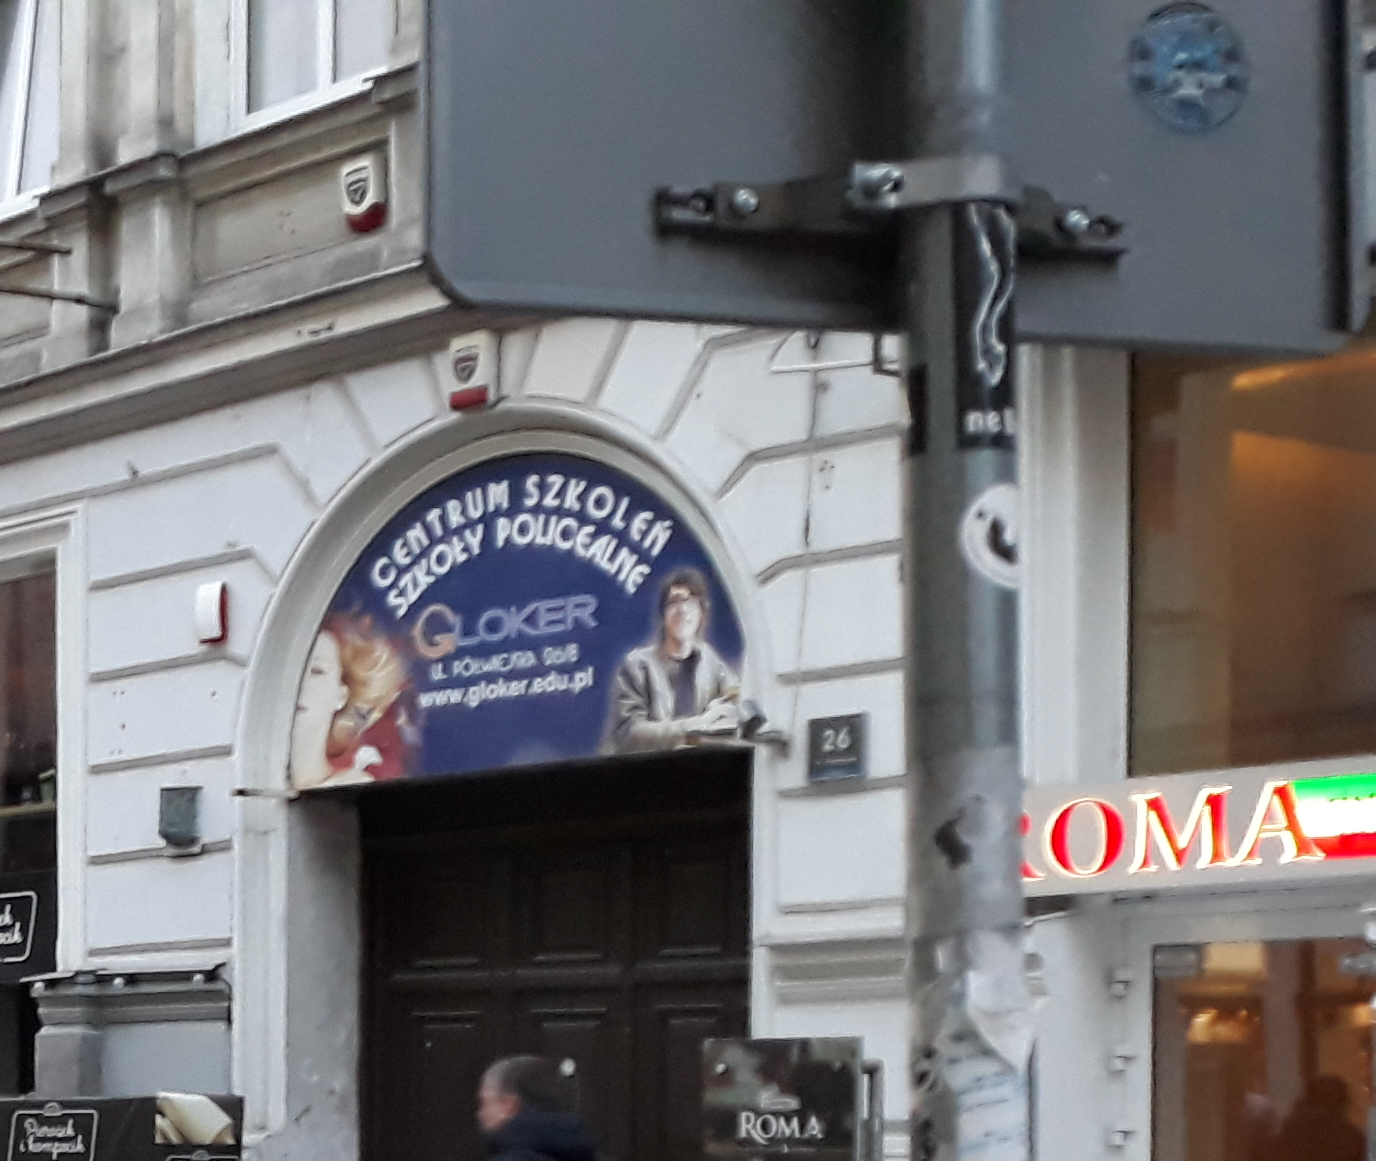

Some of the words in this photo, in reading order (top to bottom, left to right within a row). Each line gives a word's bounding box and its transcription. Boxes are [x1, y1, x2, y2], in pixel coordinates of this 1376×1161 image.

[369, 479, 511, 589] CENTRUM
[523, 473, 675, 559] SZKOLEŃ
[386, 522, 485, 620] SZKOŁY
[495, 512, 652, 596] POLICEALNE
[413, 593, 600, 661] GLOKER
[419, 665, 594, 708] www.gloker.edu.pl
[822, 726, 852, 753] 26
[738, 1110, 824, 1146] ROMA
